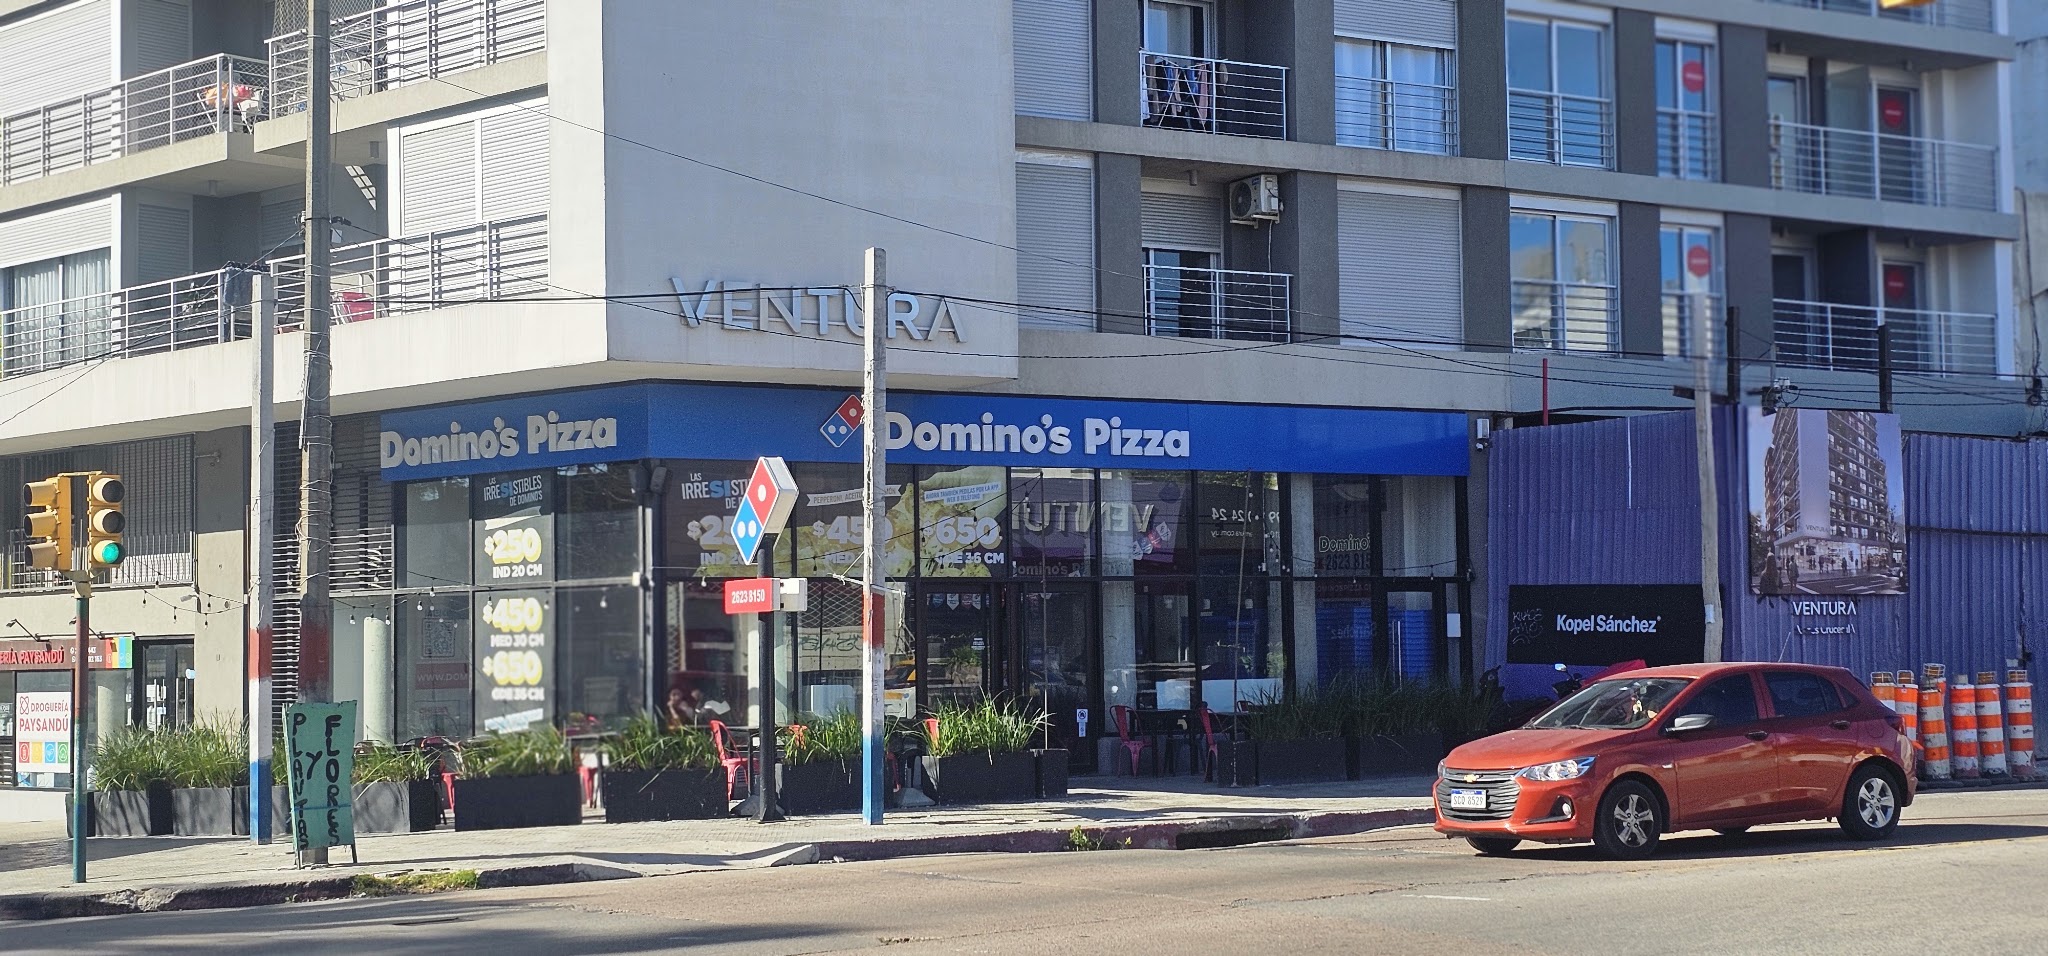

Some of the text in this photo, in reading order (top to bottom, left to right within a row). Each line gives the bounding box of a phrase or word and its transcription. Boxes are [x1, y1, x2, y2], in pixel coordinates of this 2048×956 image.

[668, 277, 968, 343] VENTURA
[380, 410, 618, 468] Domino's Pizza
[885, 411, 1190, 458] Domino's Pizza
[488, 477, 497, 485] LAS
[690, 472, 703, 482] LAS
[483, 474, 543, 502] IRRESISTIBLES
[681, 479, 751, 500] IRRESISTI
[844, 491, 865, 501] ACEITU
[509, 490, 543, 507] DE DOMINO'S
[725, 497, 737, 509] DE
[687, 514, 736, 551] $25
[812, 515, 894, 545] $45
[922, 516, 1001, 547] $650
[484, 527, 542, 565] $250
[700, 552, 727, 565] IND
[984, 552, 1005, 565] CM
[492, 563, 543, 578] IND 20 CM
[1016, 561, 1068, 576] omino's
[731, 588, 765, 605] 2623 8150
[482, 597, 543, 633] $450
[1792, 601, 1857, 616] VENTURA
[1556, 614, 1595, 635] Kopel
[1596, 614, 1657, 633] Sánchez
[528, 632, 545, 648] CM
[20, 646, 65, 664] PAYSANDÚ
[482, 650, 543, 686] $650
[31, 700, 69, 712] DROGUERÍA
[19, 714, 69, 732] PAYSANDÚ
[305, 750, 323, 780] Y
[291, 712, 310, 851] PLANTAS
[324, 713, 343, 846] FLORES
